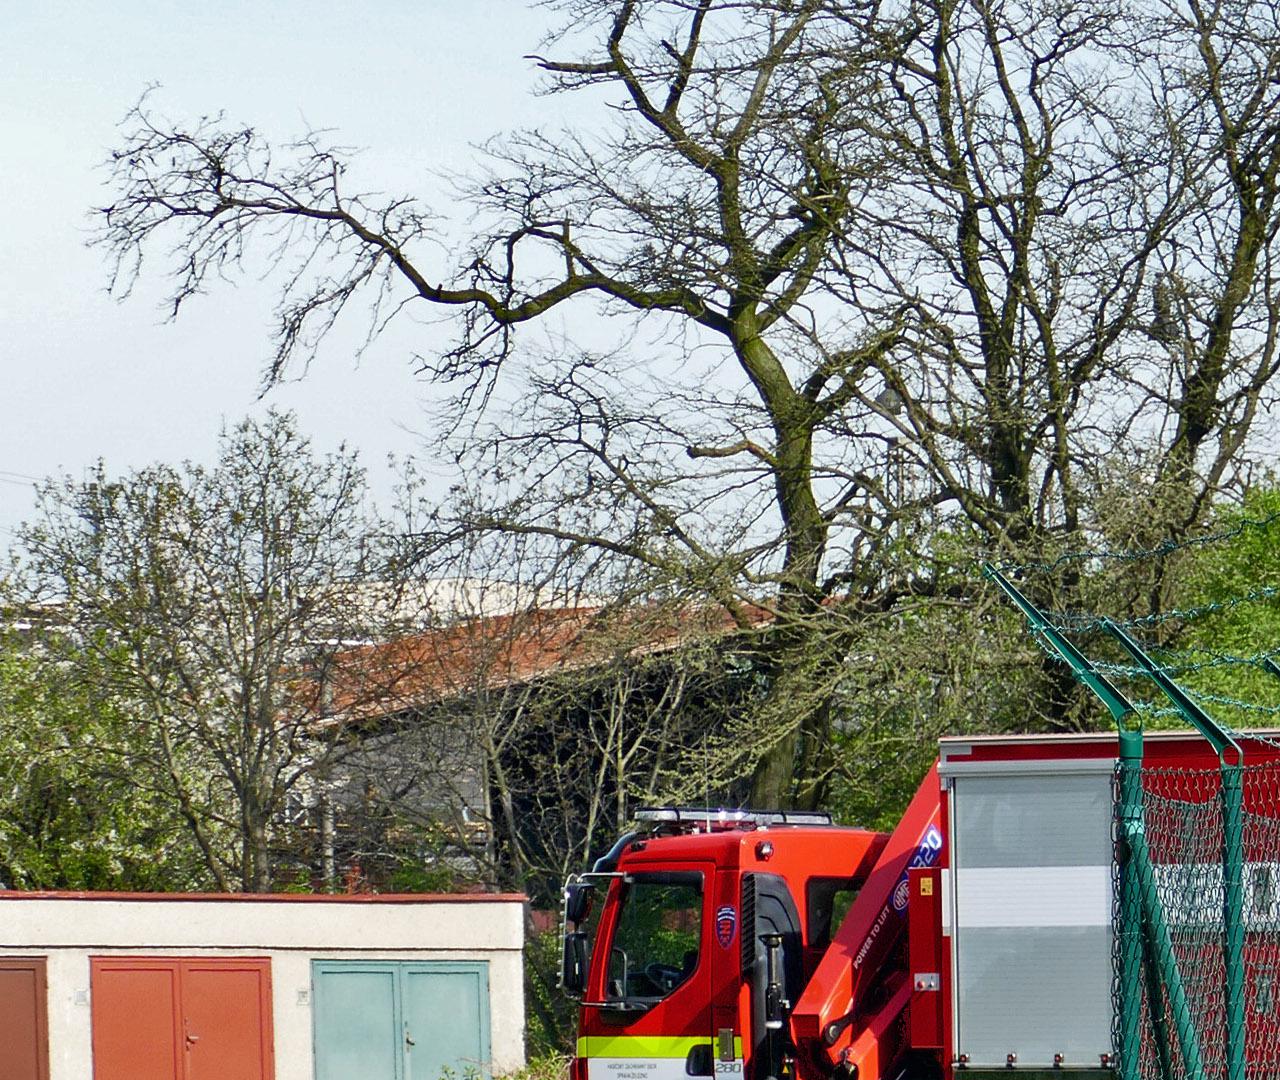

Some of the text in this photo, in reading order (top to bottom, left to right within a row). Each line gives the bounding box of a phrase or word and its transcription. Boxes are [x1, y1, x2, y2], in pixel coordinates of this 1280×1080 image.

[852, 904, 891, 970] POWER TO LIFT
[715, 1062, 741, 1074] 280
